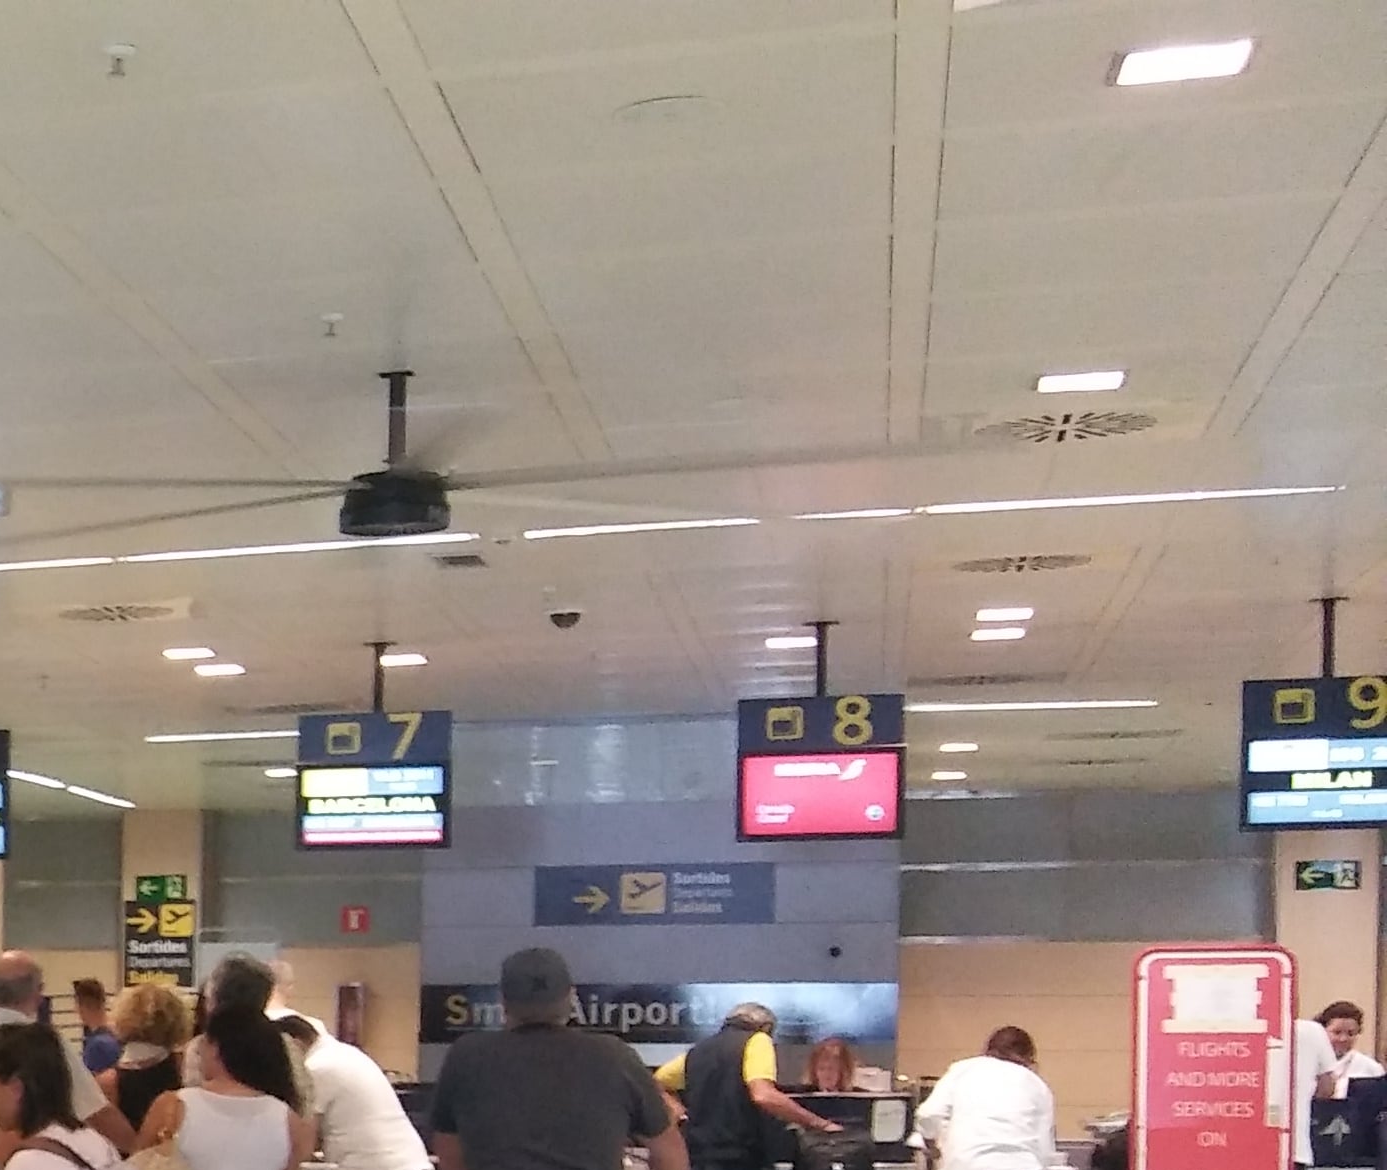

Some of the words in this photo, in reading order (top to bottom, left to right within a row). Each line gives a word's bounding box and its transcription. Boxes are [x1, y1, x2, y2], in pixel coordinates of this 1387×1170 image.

[1348, 677, 1387, 729] 9
[833, 695, 873, 746] 8
[387, 712, 423, 761] 7
[128, 939, 188, 954] Sortides
[1178, 1041, 1252, 1058] FLIGHTS
[1165, 1071, 1206, 1088] AND
[1208, 1071, 1260, 1088] MORE
[1171, 1101, 1255, 1118] SERVICES
[1197, 1131, 1227, 1147] ON
